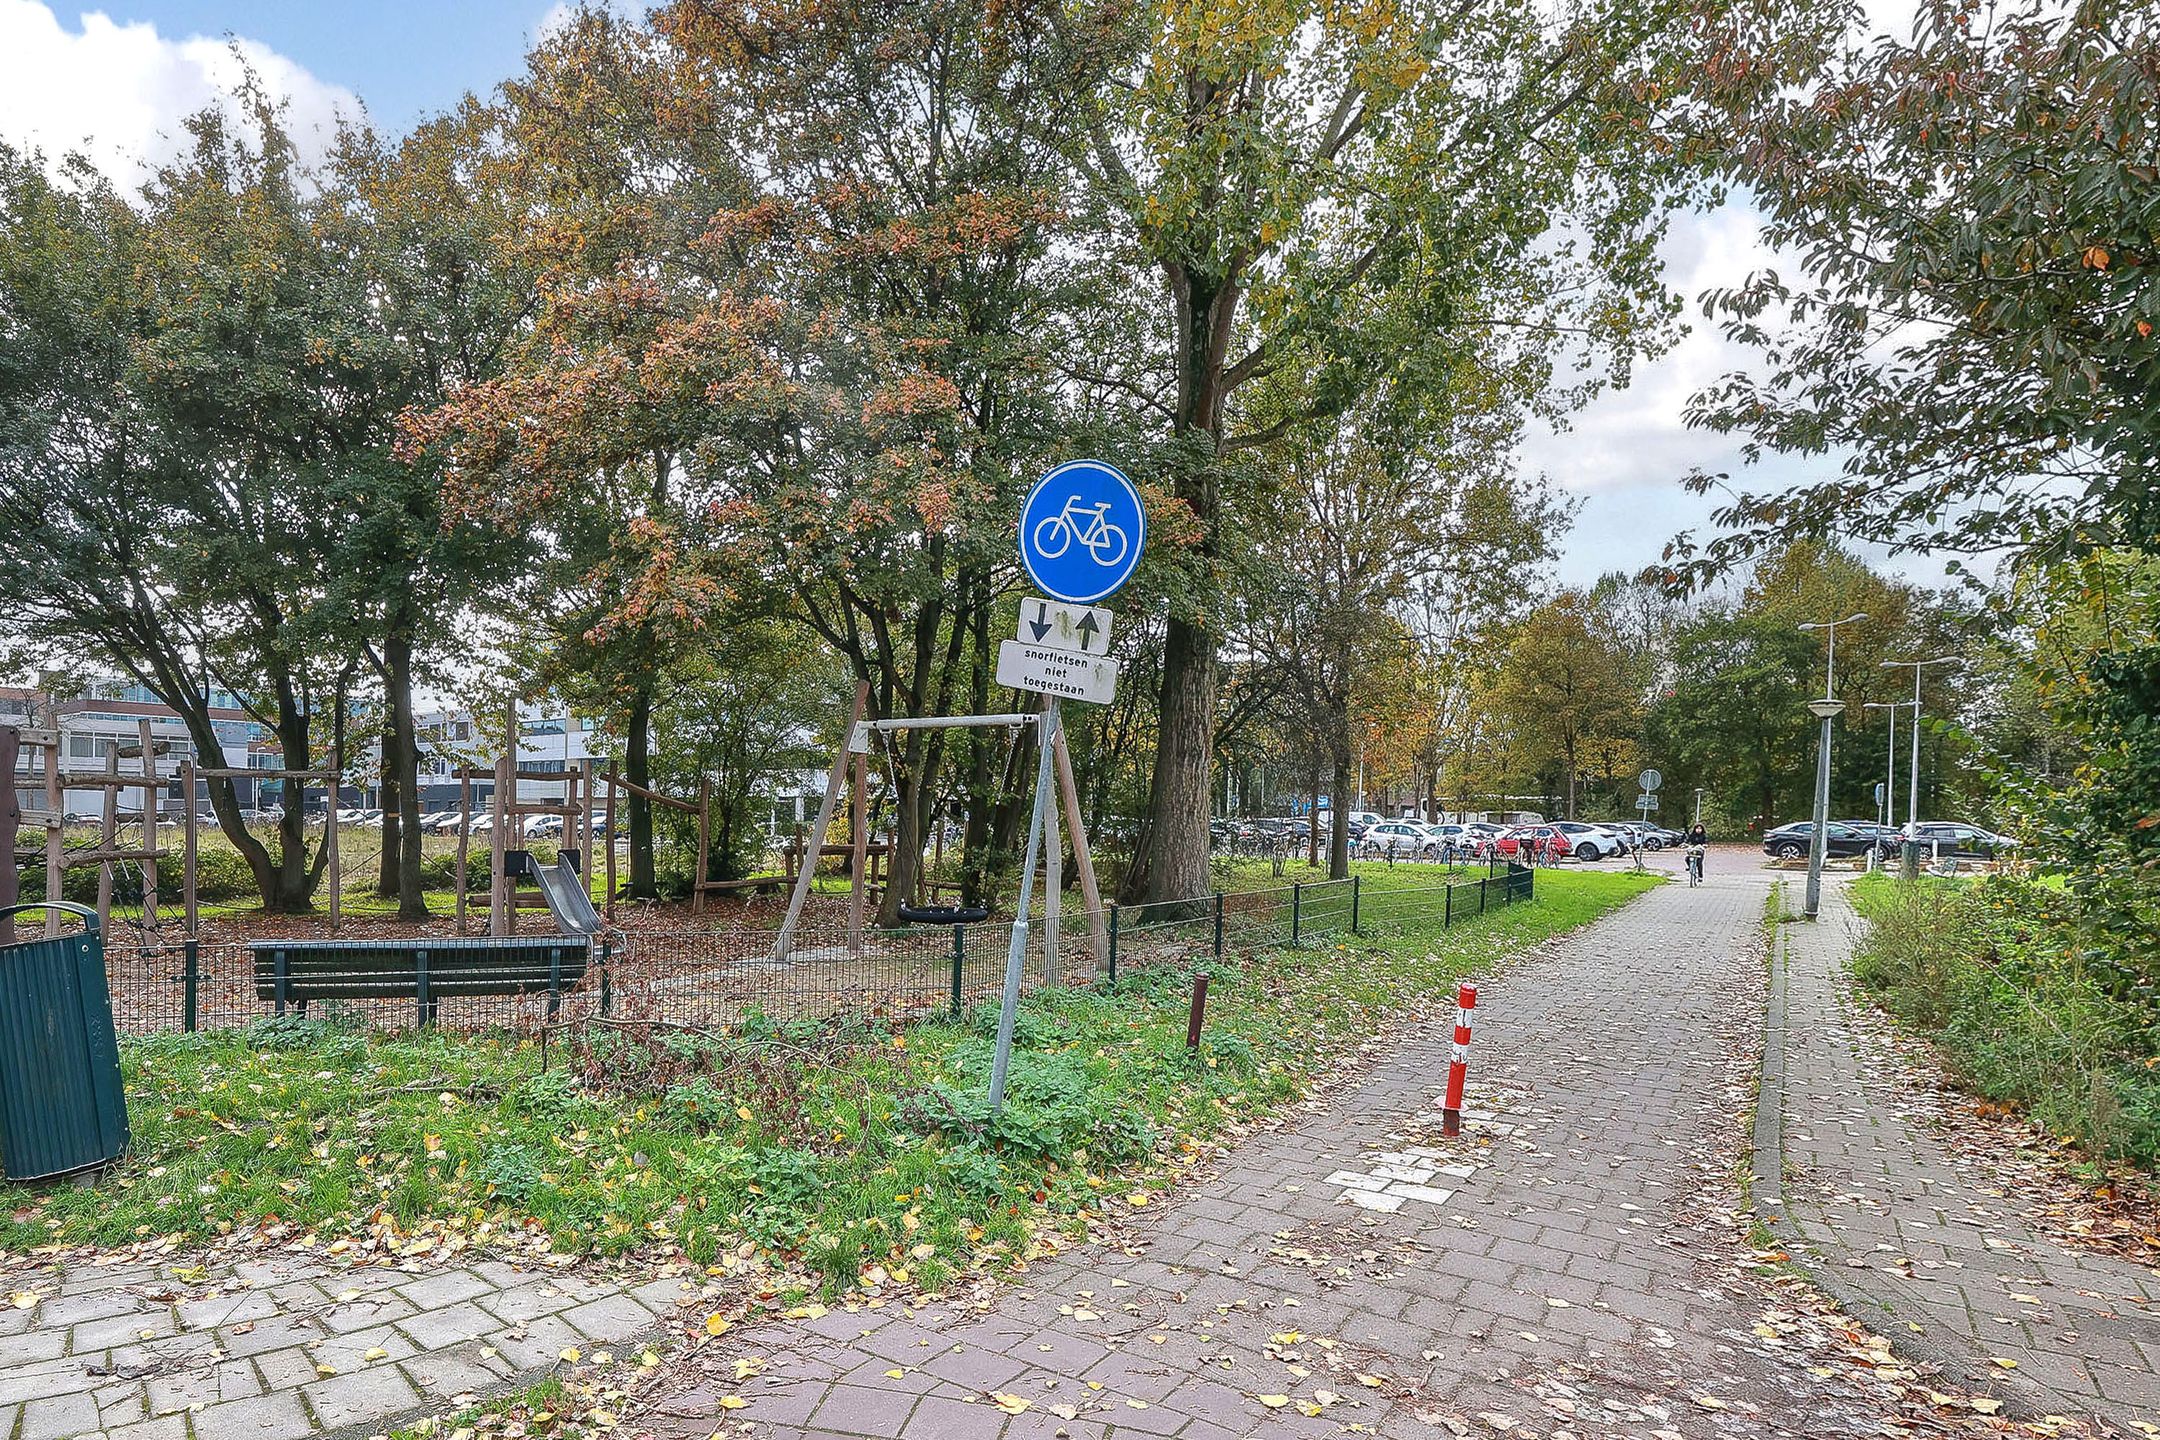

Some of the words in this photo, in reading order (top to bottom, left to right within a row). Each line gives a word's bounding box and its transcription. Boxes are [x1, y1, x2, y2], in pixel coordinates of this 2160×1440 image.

[1025, 649, 1088, 668] snorfietsen
[1045, 667, 1067, 678] niet
[1023, 675, 1085, 696] toegestaan
